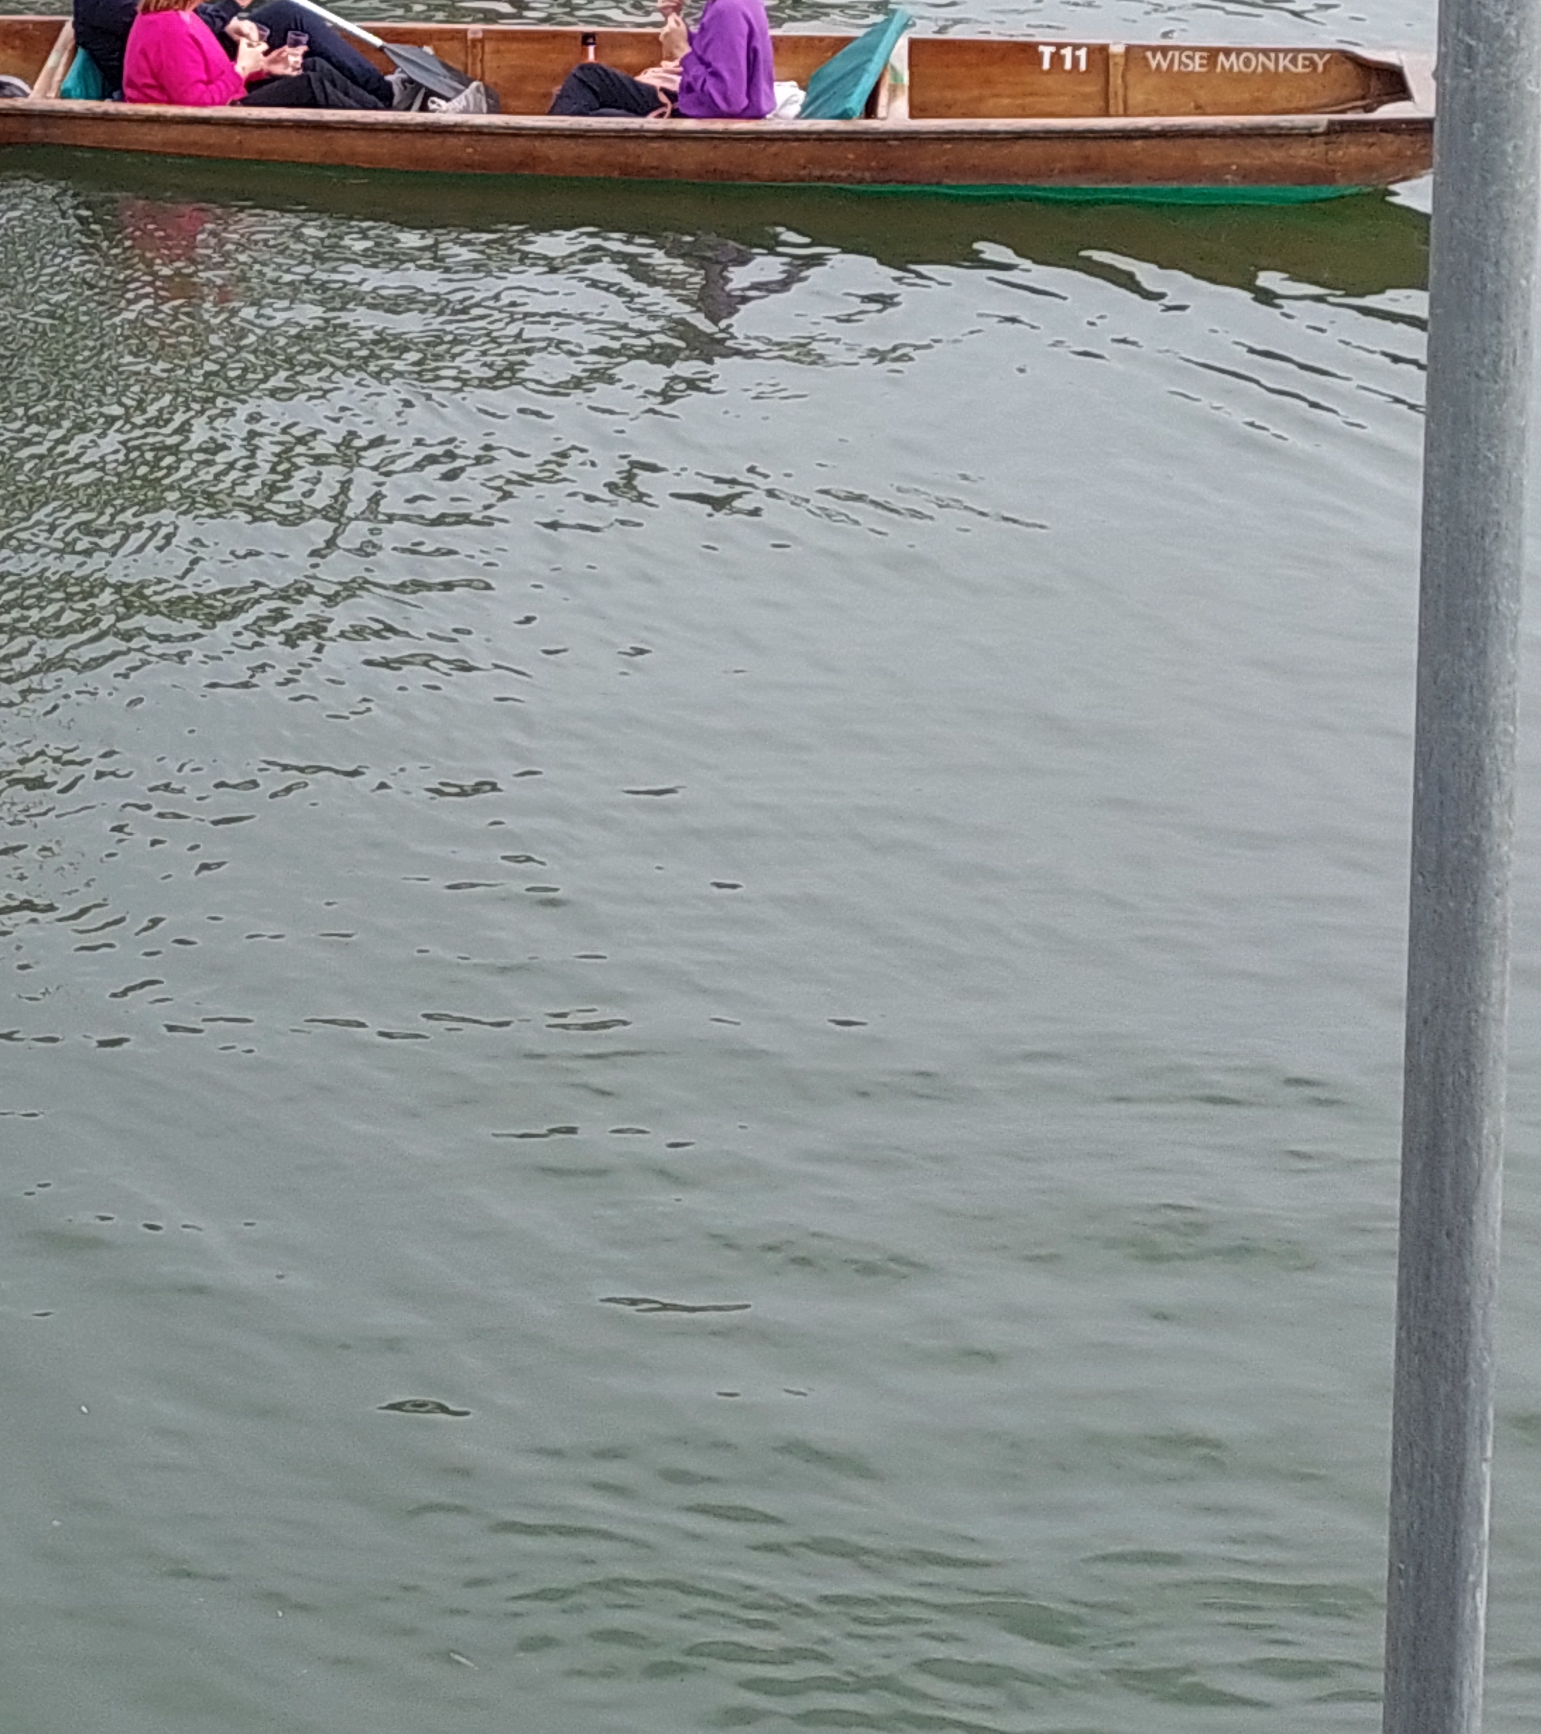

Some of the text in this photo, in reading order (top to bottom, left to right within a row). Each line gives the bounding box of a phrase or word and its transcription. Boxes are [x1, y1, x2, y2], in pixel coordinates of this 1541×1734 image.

[1038, 45, 1088, 73] T11
[1145, 50, 1332, 73] WISE MONKEY
